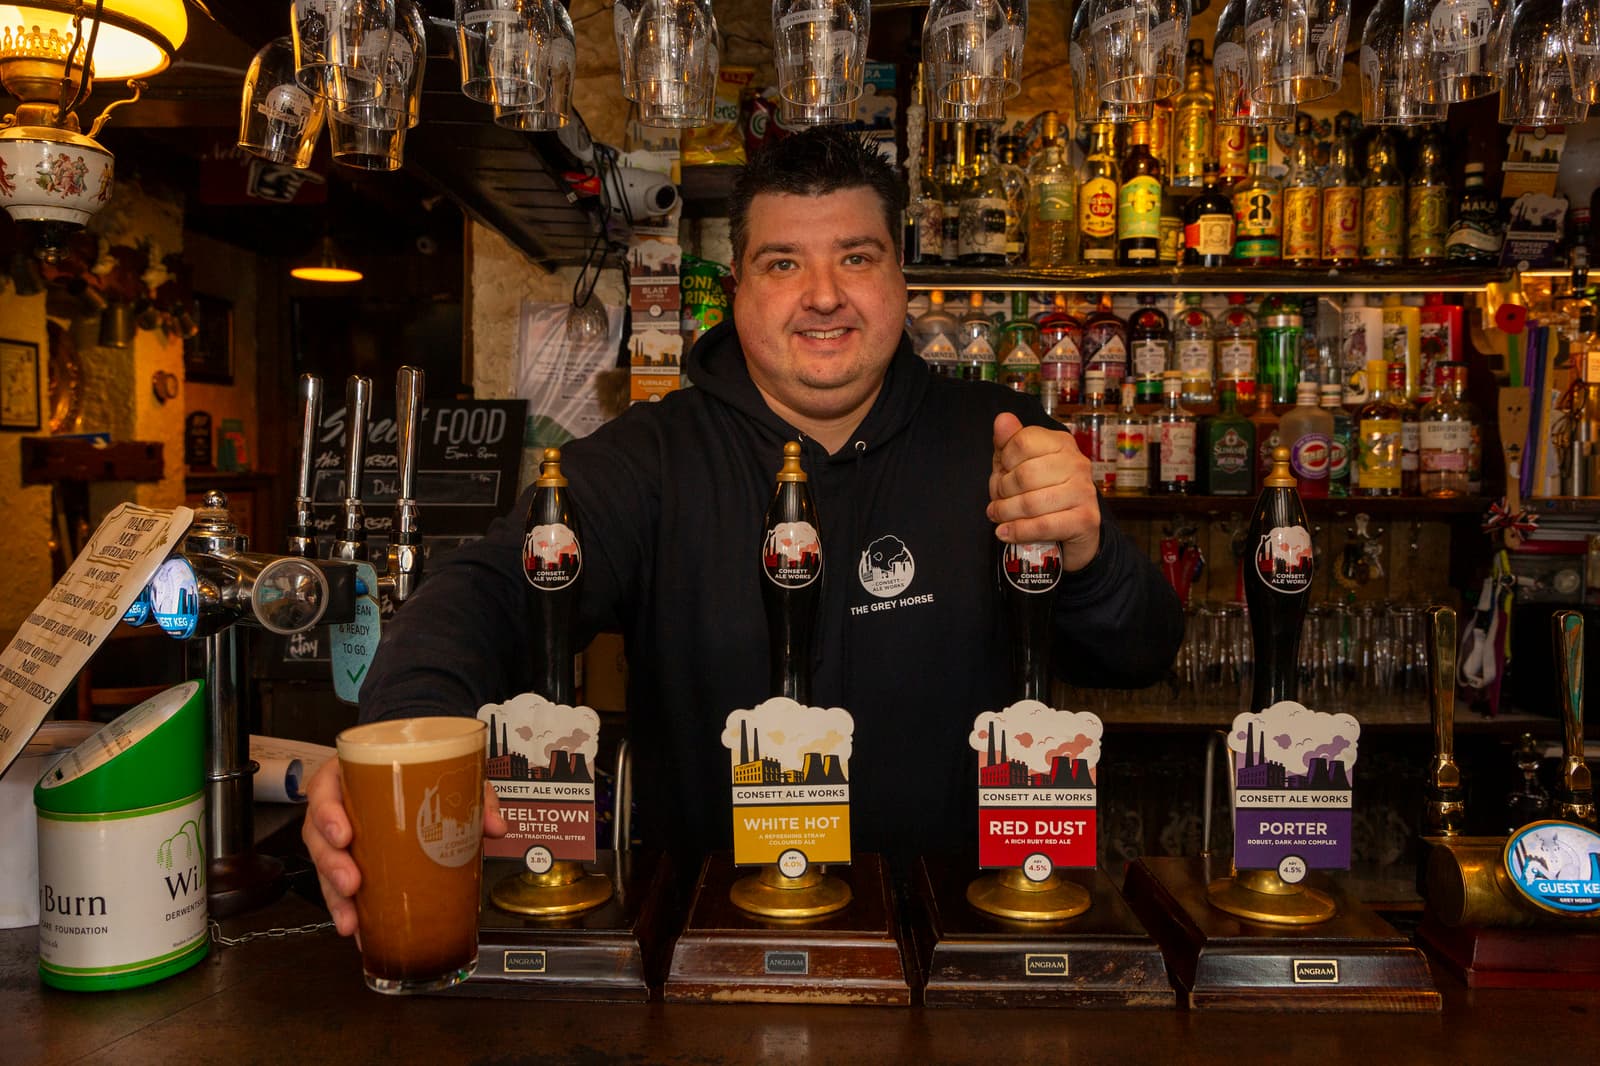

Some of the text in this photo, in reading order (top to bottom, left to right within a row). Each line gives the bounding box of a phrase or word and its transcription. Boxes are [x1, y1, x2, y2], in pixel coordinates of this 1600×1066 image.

[641, 287, 669, 295] BLAST
[684, 290, 728, 308] RINGS
[433, 408, 507, 445] FOOD
[850, 593, 935, 616] THE GREY HORSE
[356, 604, 372, 617] EAN
[174, 617, 188, 627] KEG
[346, 623, 371, 636] READY
[342, 642, 369, 657] TO GO.
[493, 784, 591, 796] ONSETT ALE WORKS
[736, 789, 846, 800] CONSETT ALE WORKS
[982, 793, 1093, 802] CONSETT ALE WORKS
[1239, 794, 1349, 804] CONSETT ALE WORKS
[499, 807, 590, 823] TEELTOWN
[519, 823, 559, 833] BITTER
[743, 816, 841, 831] WHITE HOT
[989, 820, 1087, 836] RED DUST
[1259, 822, 1328, 836] PORTER
[524, 833, 564, 841] TRADITIONAL
[783, 861, 803, 869] 4.0%
[1028, 864, 1048, 872] 4.5%
[1283, 866, 1302, 874] 4.5%
[1538, 882, 1600, 894] GUEST KE
[44, 884, 108, 917] Burn
[55, 924, 109, 936] FOUNDATION
[507, 957, 542, 966] ANGRAM
[769, 959, 804, 967] ANGRAM
[1029, 960, 1065, 969] ANGRAM
[1298, 967, 1335, 976] ANGRAM
